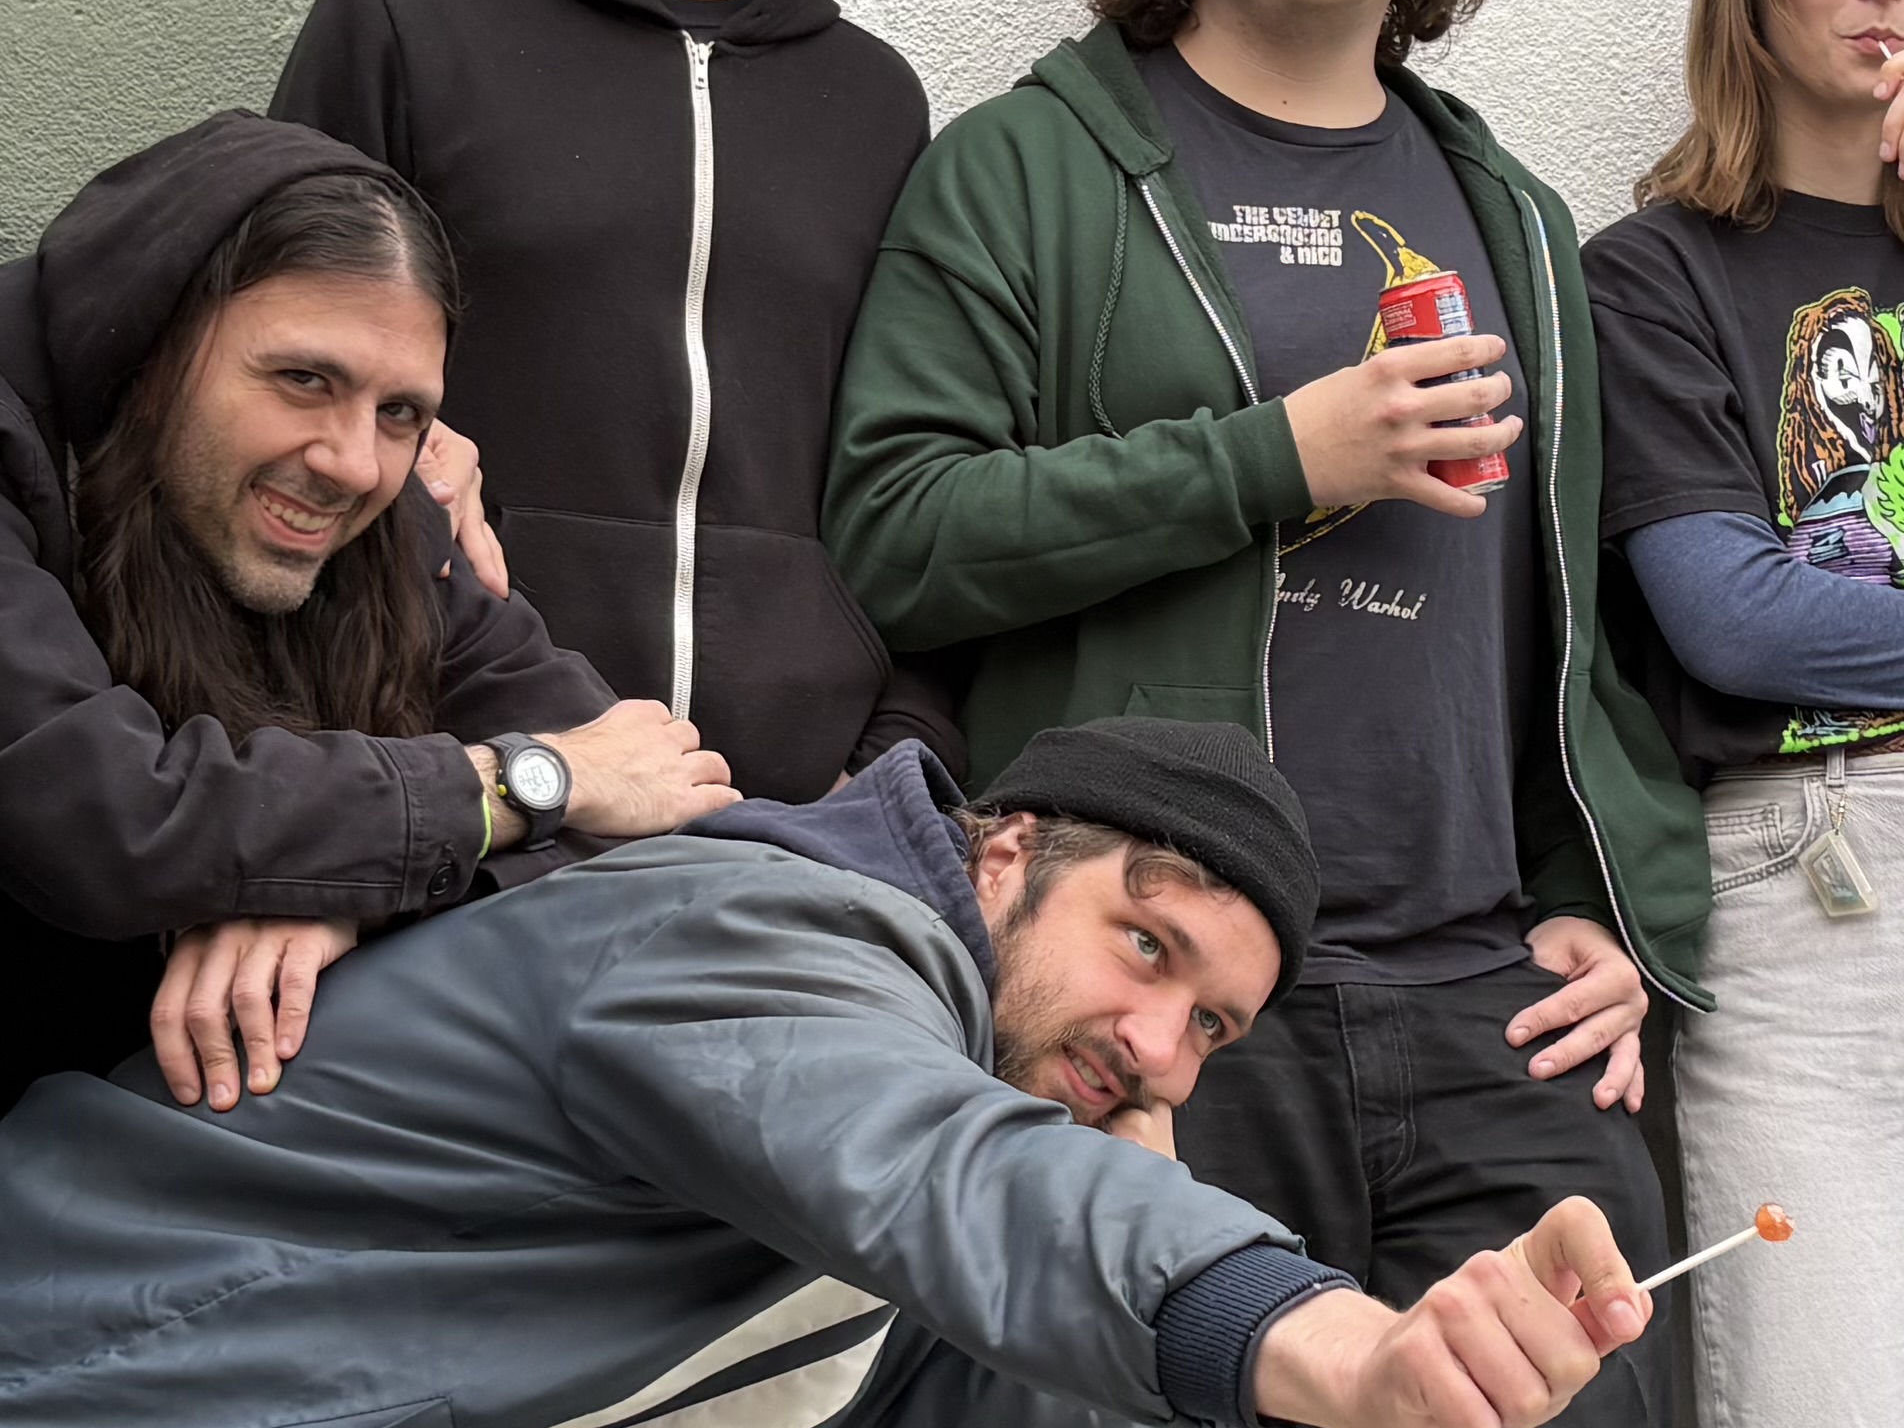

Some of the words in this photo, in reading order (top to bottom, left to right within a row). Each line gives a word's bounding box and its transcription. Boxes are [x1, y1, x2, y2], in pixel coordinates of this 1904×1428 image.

[1232, 204, 1270, 225] THE
[1279, 245, 1296, 265] &
[1297, 246, 1343, 267] NICO
[1338, 578, 1428, 621] Warhol
